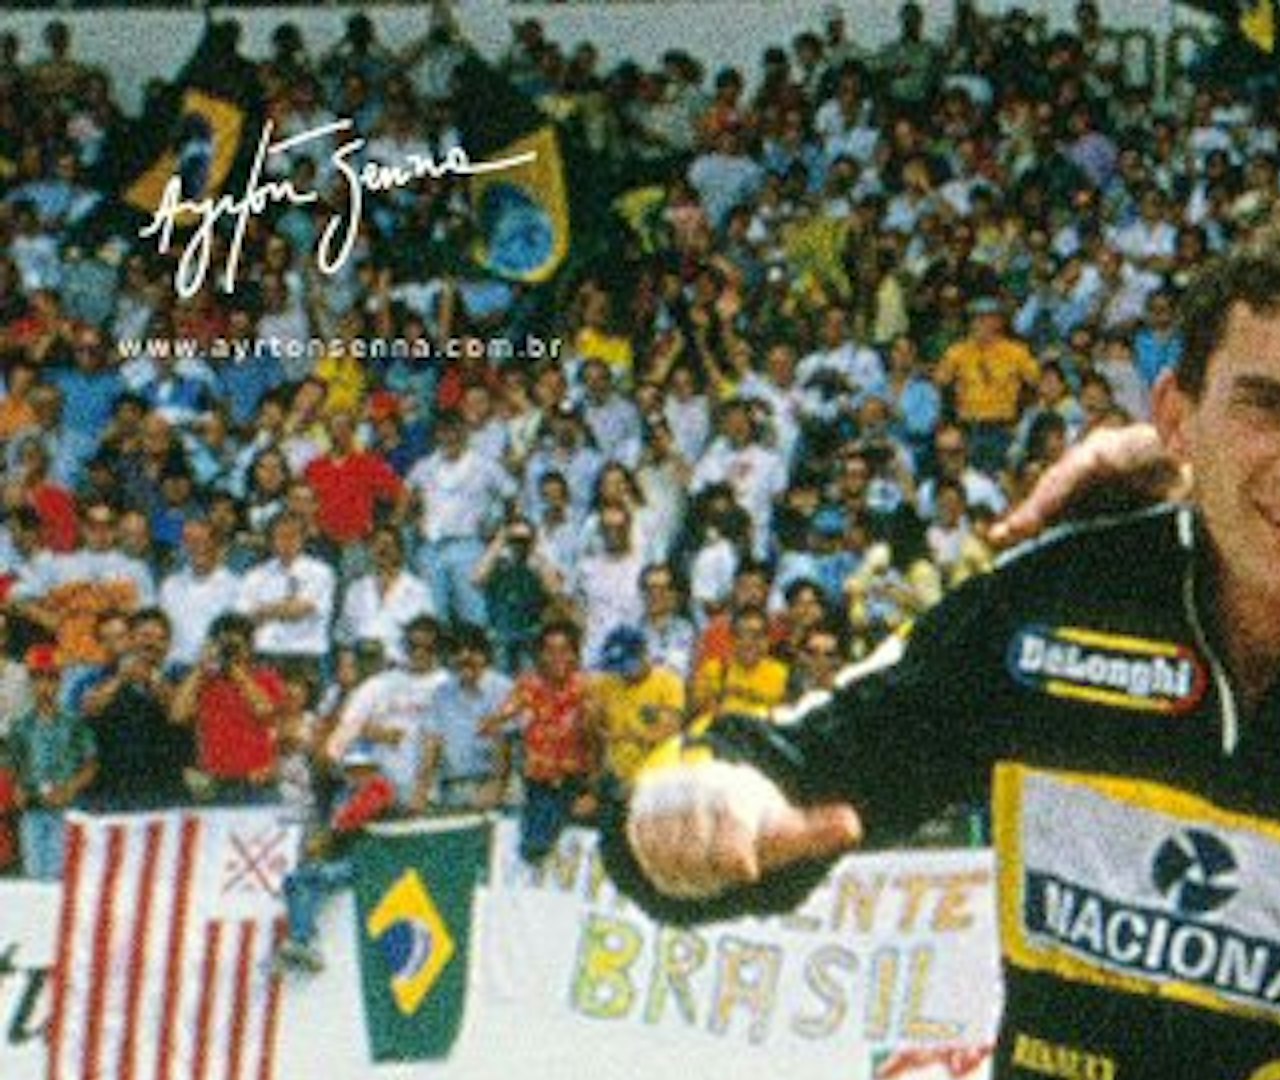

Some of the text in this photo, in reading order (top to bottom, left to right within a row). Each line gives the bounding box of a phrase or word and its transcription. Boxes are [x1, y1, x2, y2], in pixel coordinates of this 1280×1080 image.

[1015, 632, 1192, 698] DeLonghi
[780, 868, 992, 934] NTE
[568, 920, 964, 1046] BRASIL
